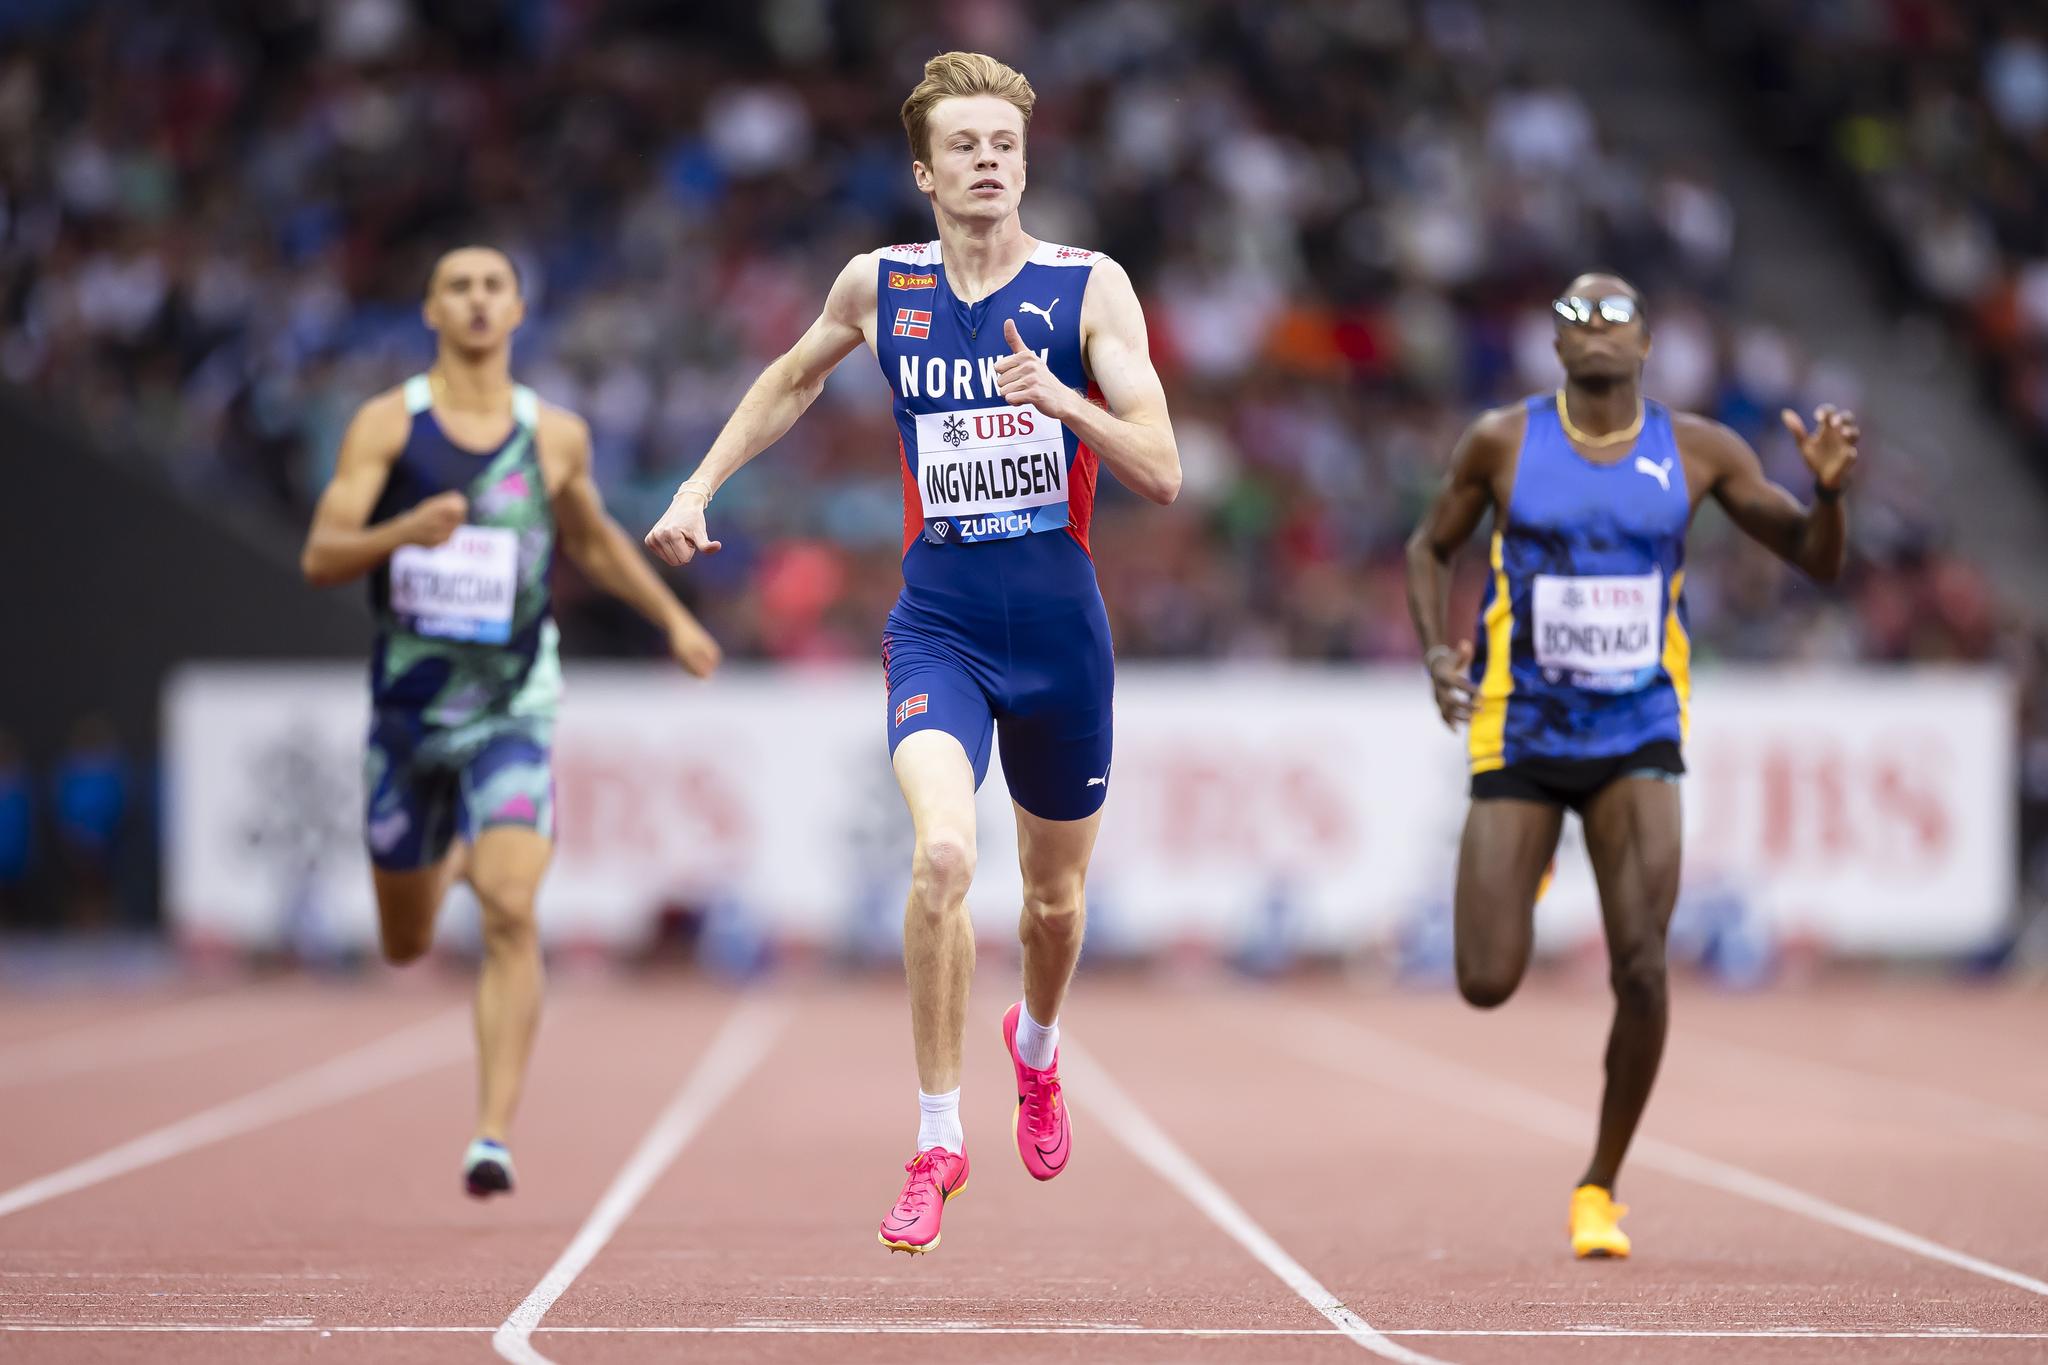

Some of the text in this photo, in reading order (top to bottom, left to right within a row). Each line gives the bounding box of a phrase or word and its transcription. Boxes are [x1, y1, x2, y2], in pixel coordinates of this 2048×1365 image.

[900, 348, 1049, 400] NORW
[973, 411, 1035, 440] UBS
[926, 451, 1061, 506] INGVALDSEN
[959, 513, 1032, 538] ZURICH
